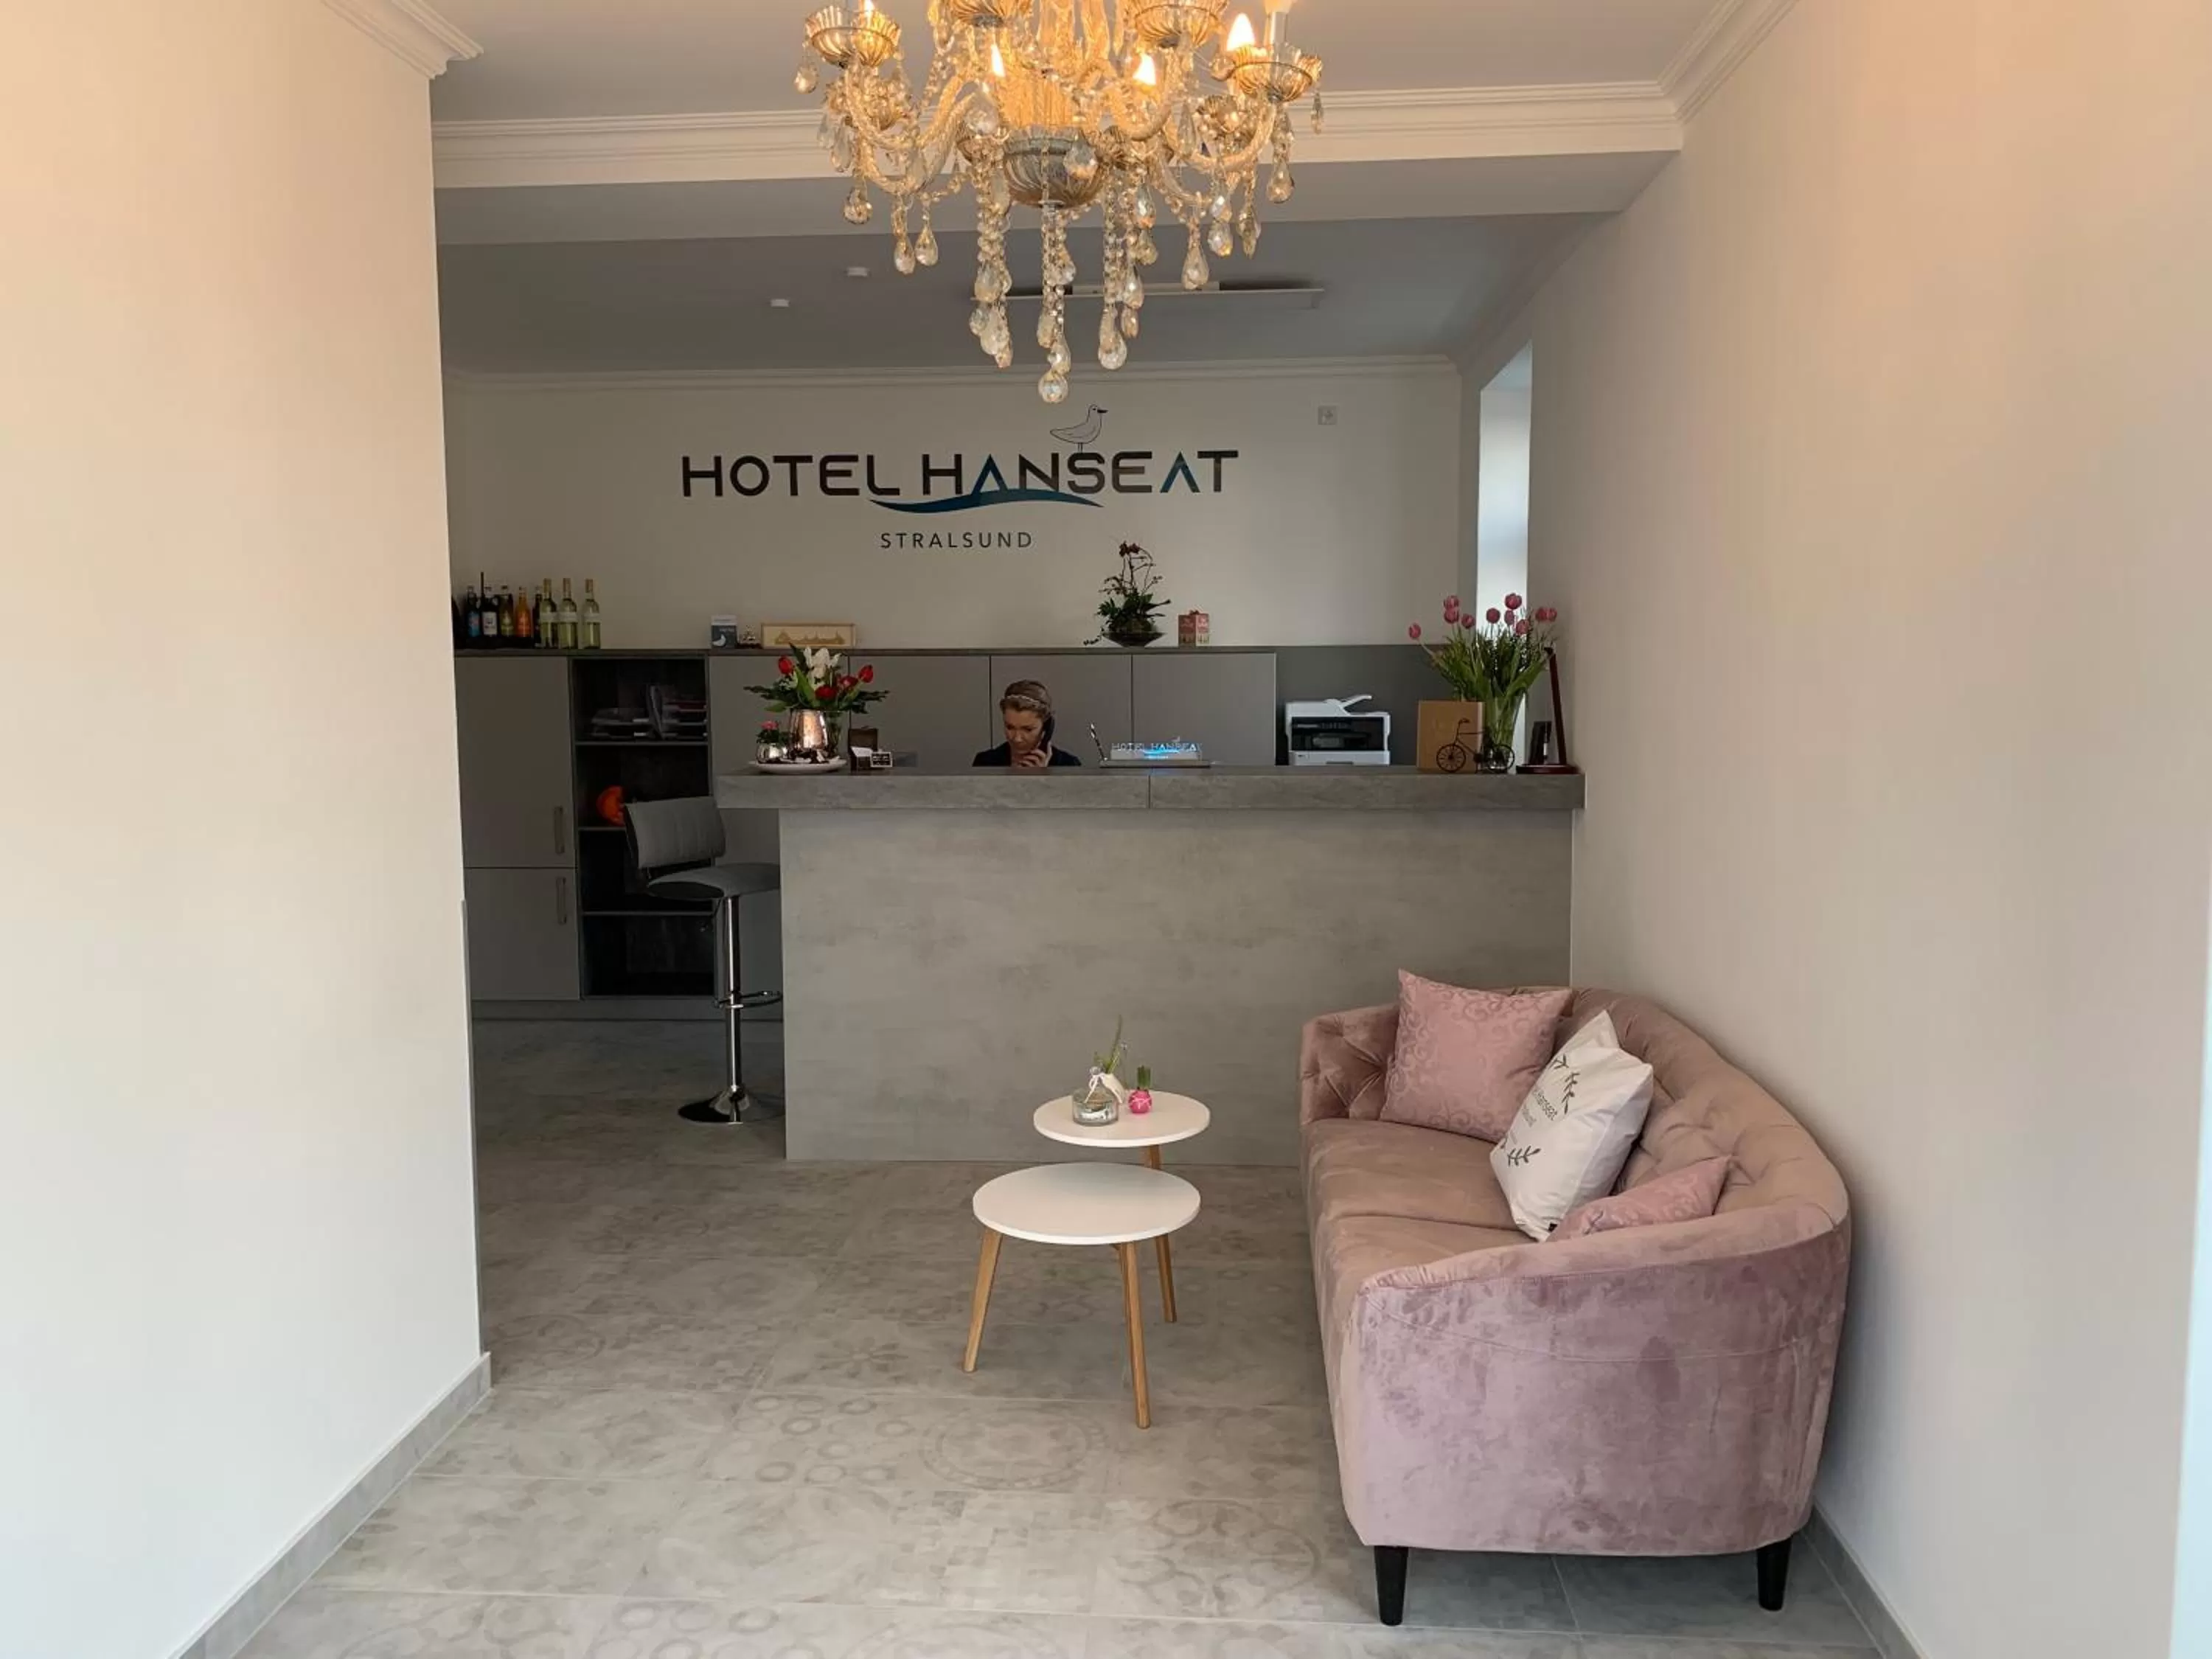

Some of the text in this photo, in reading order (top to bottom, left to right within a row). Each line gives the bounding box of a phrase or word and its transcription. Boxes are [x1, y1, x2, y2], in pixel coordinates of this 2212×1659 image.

[682, 451, 1239, 497] HOTEL HANSEAT
[880, 532, 1032, 549] STRALSUND
[1111, 742, 1145, 751] HOTEL
